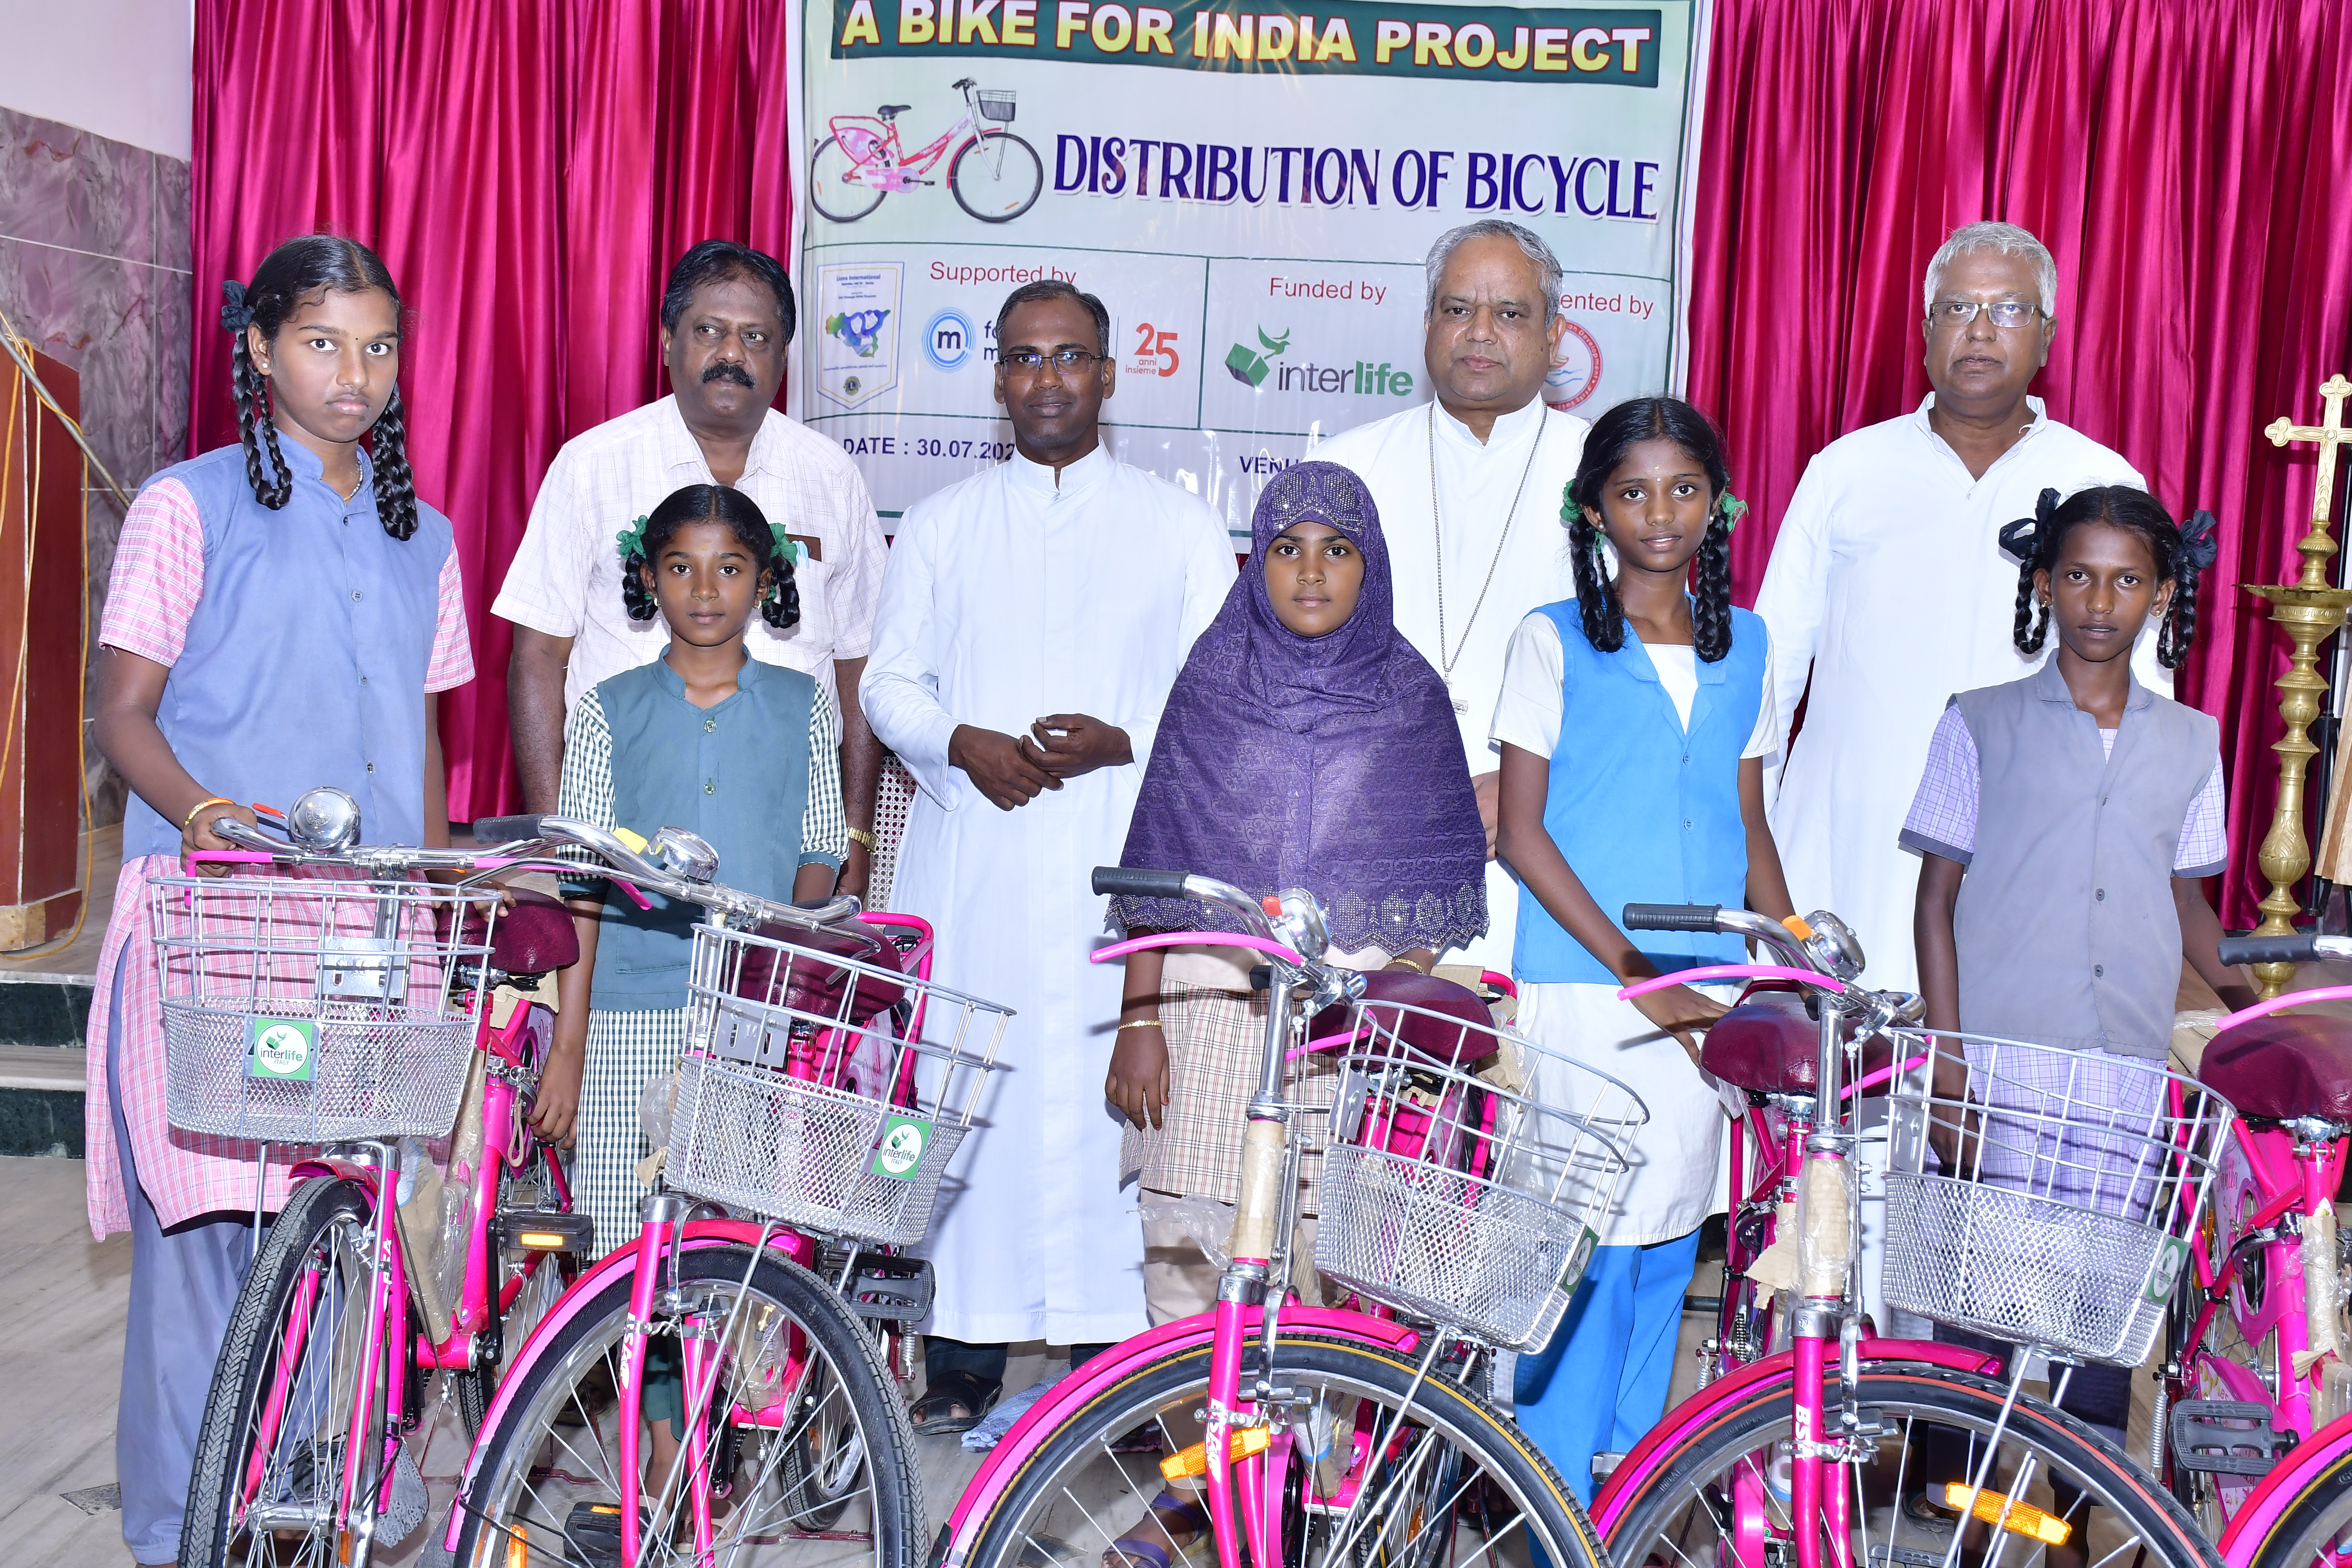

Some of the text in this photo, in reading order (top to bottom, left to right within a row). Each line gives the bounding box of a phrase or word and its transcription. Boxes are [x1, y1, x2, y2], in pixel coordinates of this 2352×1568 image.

[841, 0, 1651, 73] A BIKE FOR INDIA PROJECT
[1054, 134, 1659, 220] DISTRIBUTION OF BICYCLE
[930, 261, 1043, 286] Supported
[1269, 277, 1387, 306] Funded by
[1629, 295, 1654, 320] by
[937, 331, 961, 349] m
[1134, 323, 1179, 377] 25
[1138, 357, 1157, 366] anni
[1578, 330, 1600, 379] Development
[1125, 365, 1157, 375] insieme
[1278, 360, 1413, 396] interlife
[844, 437, 896, 455] DATE
[917, 438, 1015, 460] 30.07.202
[260, 1048, 303, 1062] interlife
[883, 1146, 916, 1162] interlife
